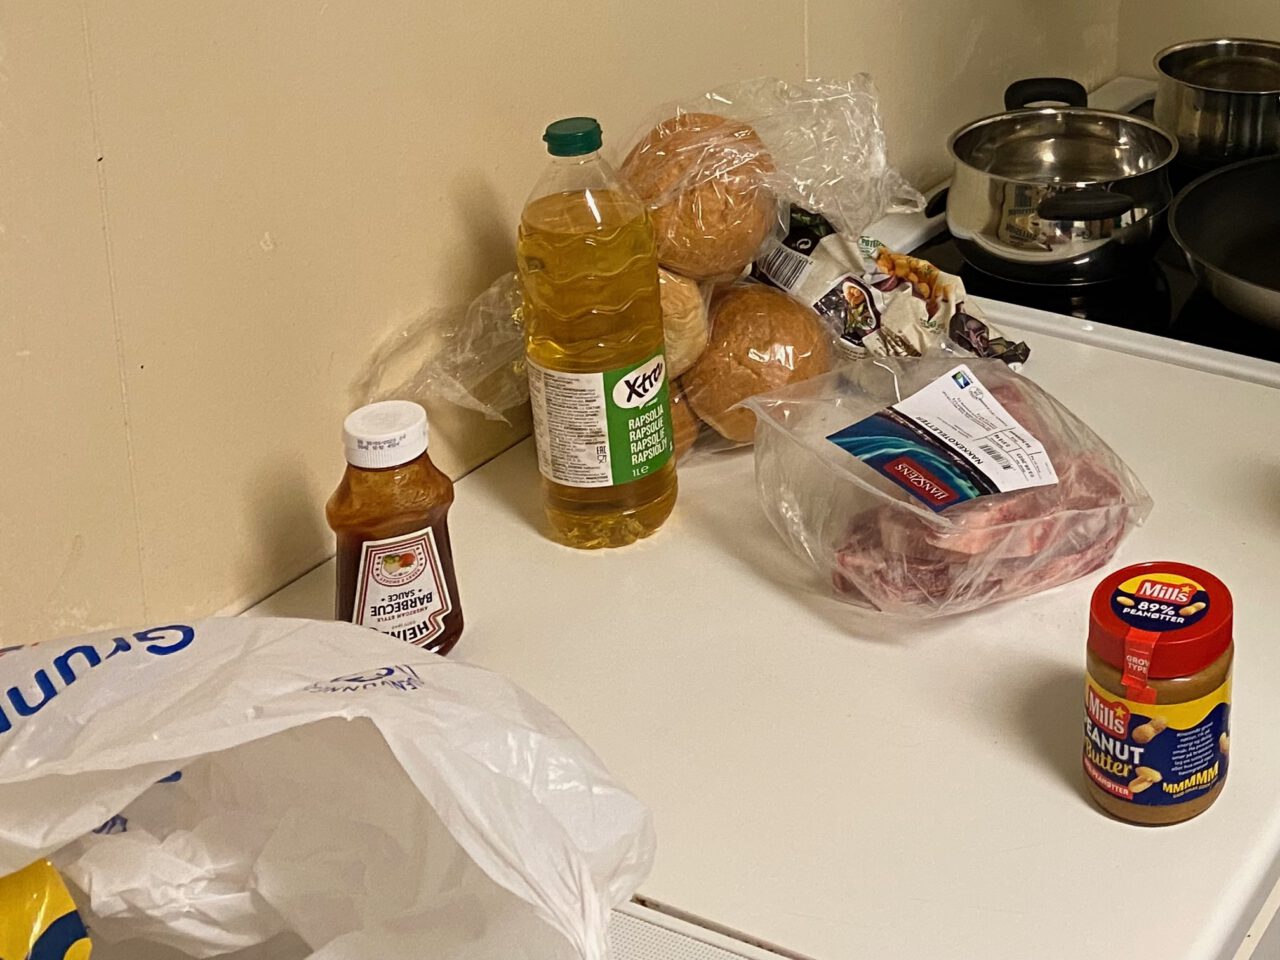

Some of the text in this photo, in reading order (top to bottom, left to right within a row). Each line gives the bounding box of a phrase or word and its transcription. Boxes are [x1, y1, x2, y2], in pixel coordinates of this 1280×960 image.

[624, 363, 663, 403] Xtra
[628, 404, 664, 430] RAPSOLJA
[916, 415, 984, 465] NAKKEKOTELETTER
[388, 589, 416, 602] SAUCE
[1139, 581, 1189, 603] Mills
[370, 592, 433, 617] BARBECUE
[377, 606, 428, 623] AMERICAN STYLE
[1122, 607, 1185, 624] PEANØTTER
[1137, 601, 1175, 616] 89%
[1128, 662, 1147, 674] TYPE
[1088, 690, 1125, 735] Mills
[1085, 736, 1133, 778] Butter
